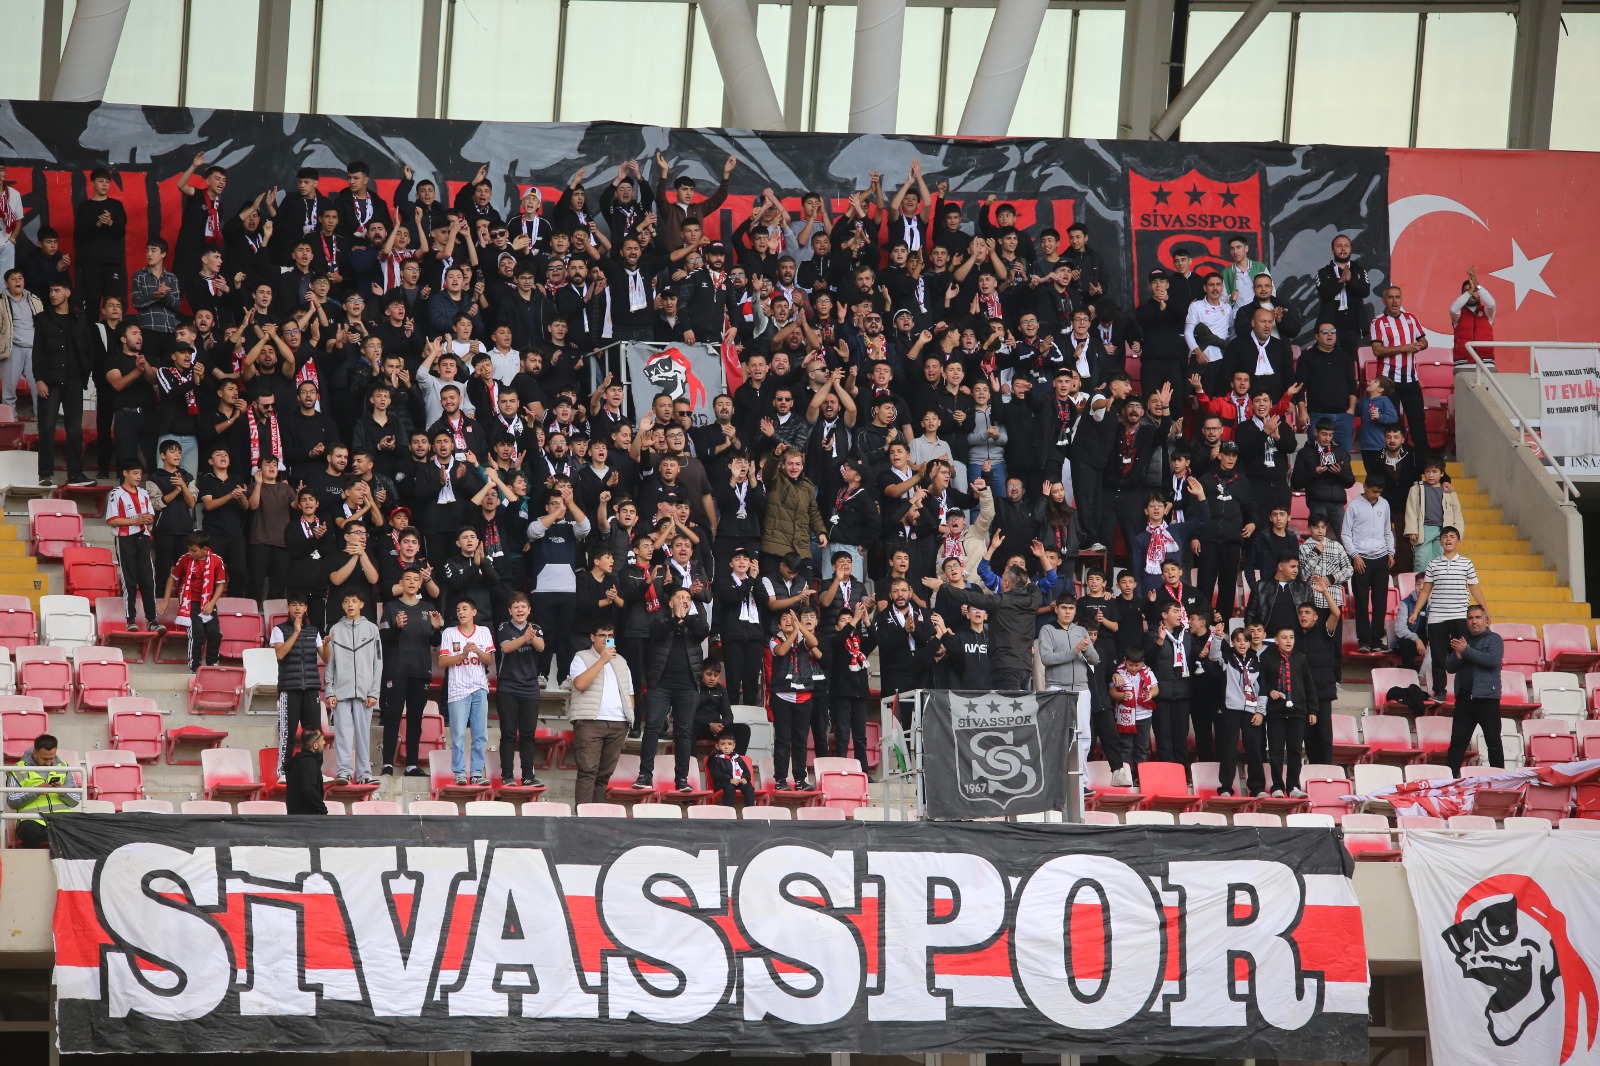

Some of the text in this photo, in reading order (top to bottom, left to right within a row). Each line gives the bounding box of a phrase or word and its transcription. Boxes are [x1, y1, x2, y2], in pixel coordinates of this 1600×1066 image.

[1140, 209, 1252, 230] SİVASSPOR
[1544, 385, 1557, 400] 17
[964, 643, 988, 654] NAS
[957, 715, 1032, 728] SİVASSPOR
[964, 782, 987, 794] 1967
[96, 839, 1322, 1032] SİVASSPOR
